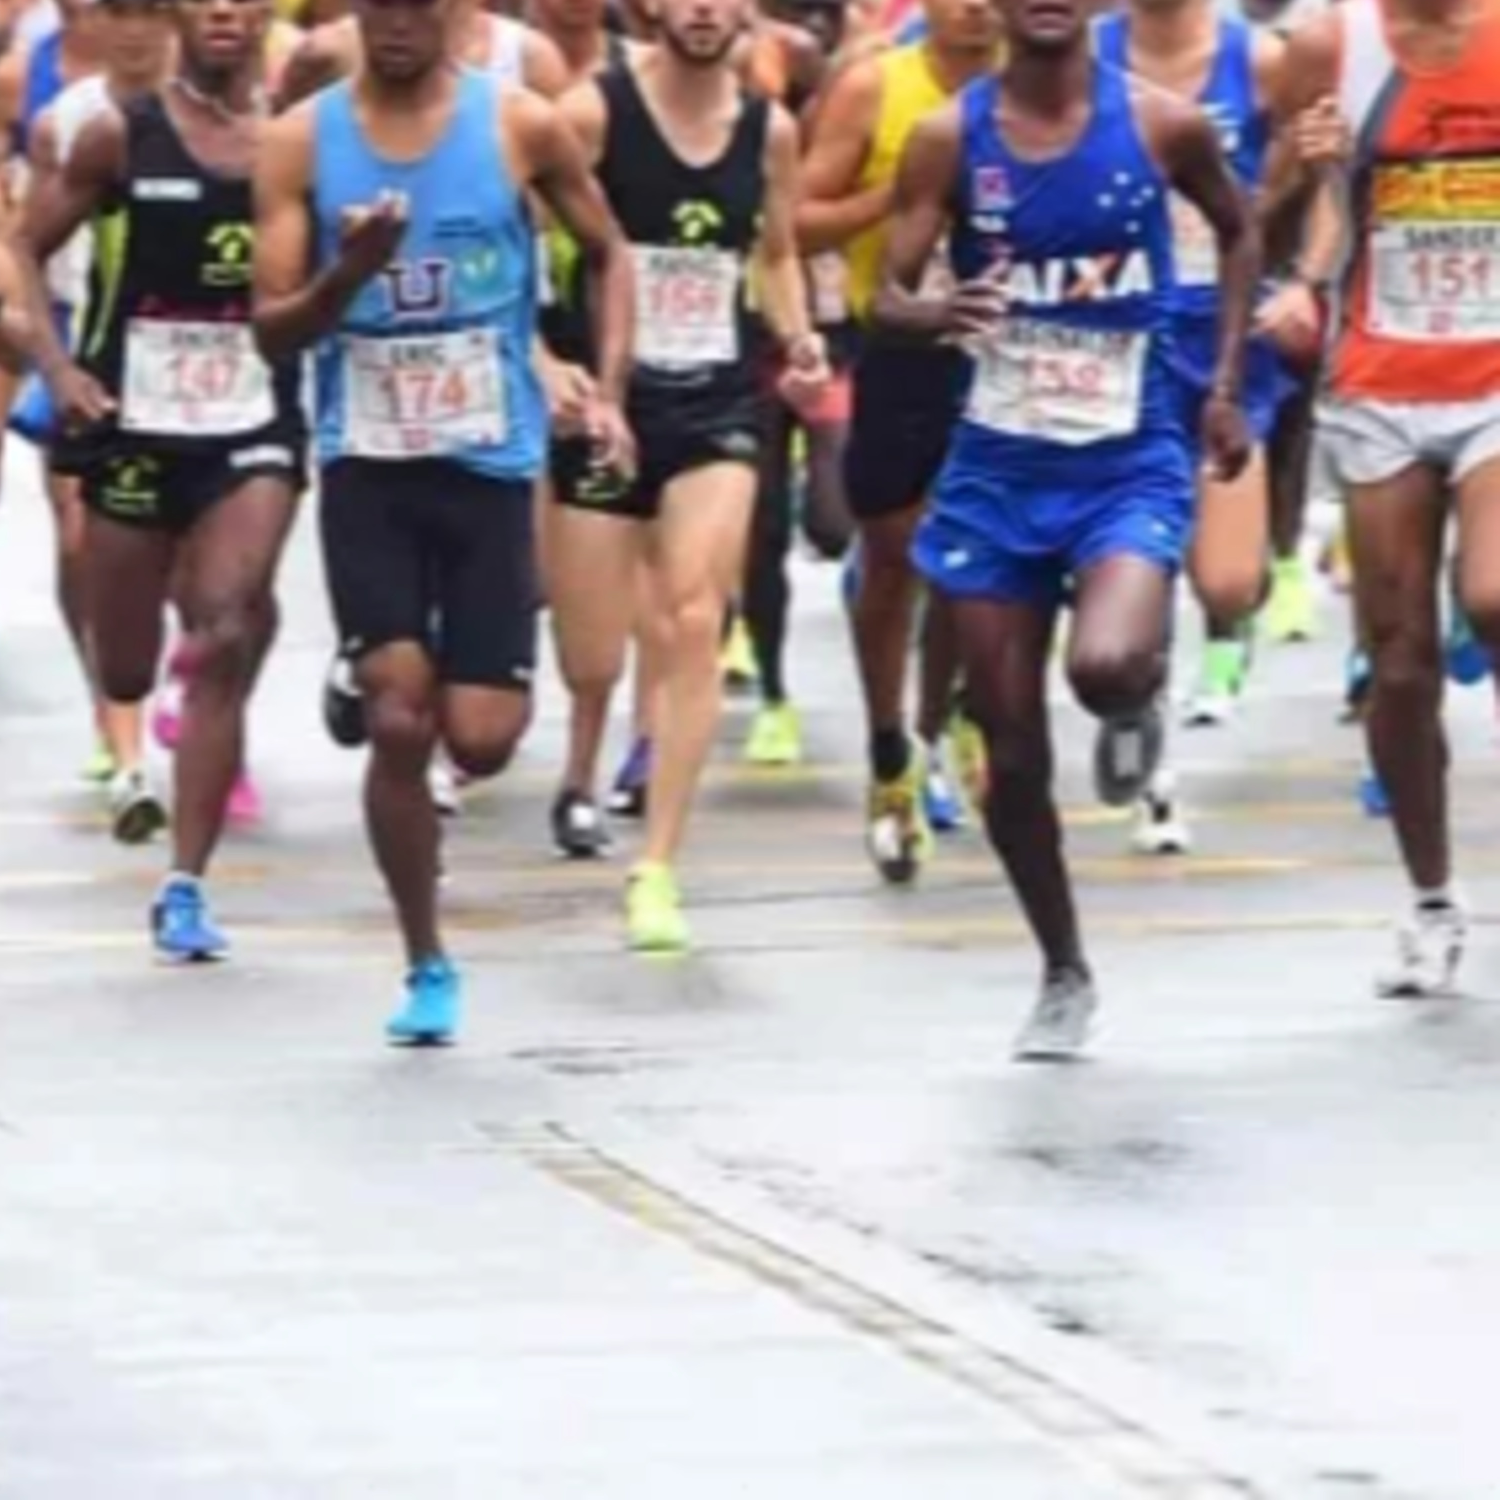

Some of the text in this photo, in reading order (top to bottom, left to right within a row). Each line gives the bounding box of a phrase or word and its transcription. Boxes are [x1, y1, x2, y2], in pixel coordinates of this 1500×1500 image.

[1003, 248, 1155, 308] AIXA
[1409, 252, 1491, 301] 151
[381, 368, 466, 418] 174
